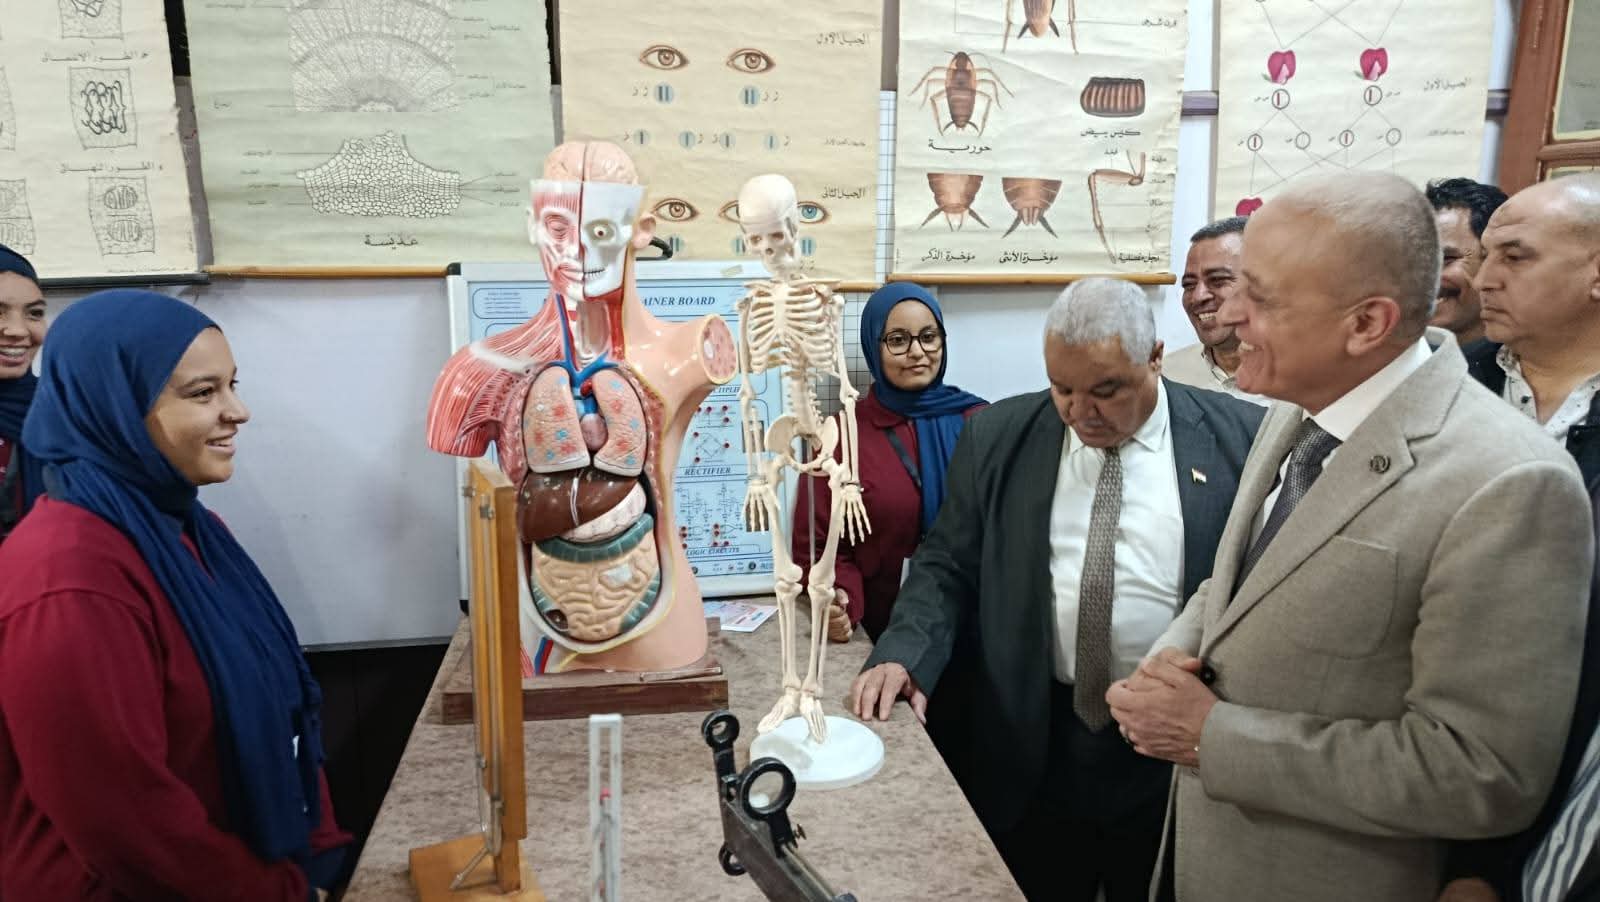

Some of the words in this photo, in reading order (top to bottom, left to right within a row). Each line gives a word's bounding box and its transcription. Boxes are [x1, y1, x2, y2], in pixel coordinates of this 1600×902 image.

[928, 138, 992, 154] حورية
[677, 296, 716, 306] BOARD
[684, 466, 732, 476] RECTIFIER
[686, 548, 708, 556] LOGIC
[708, 547, 740, 555] CIRCUITS
